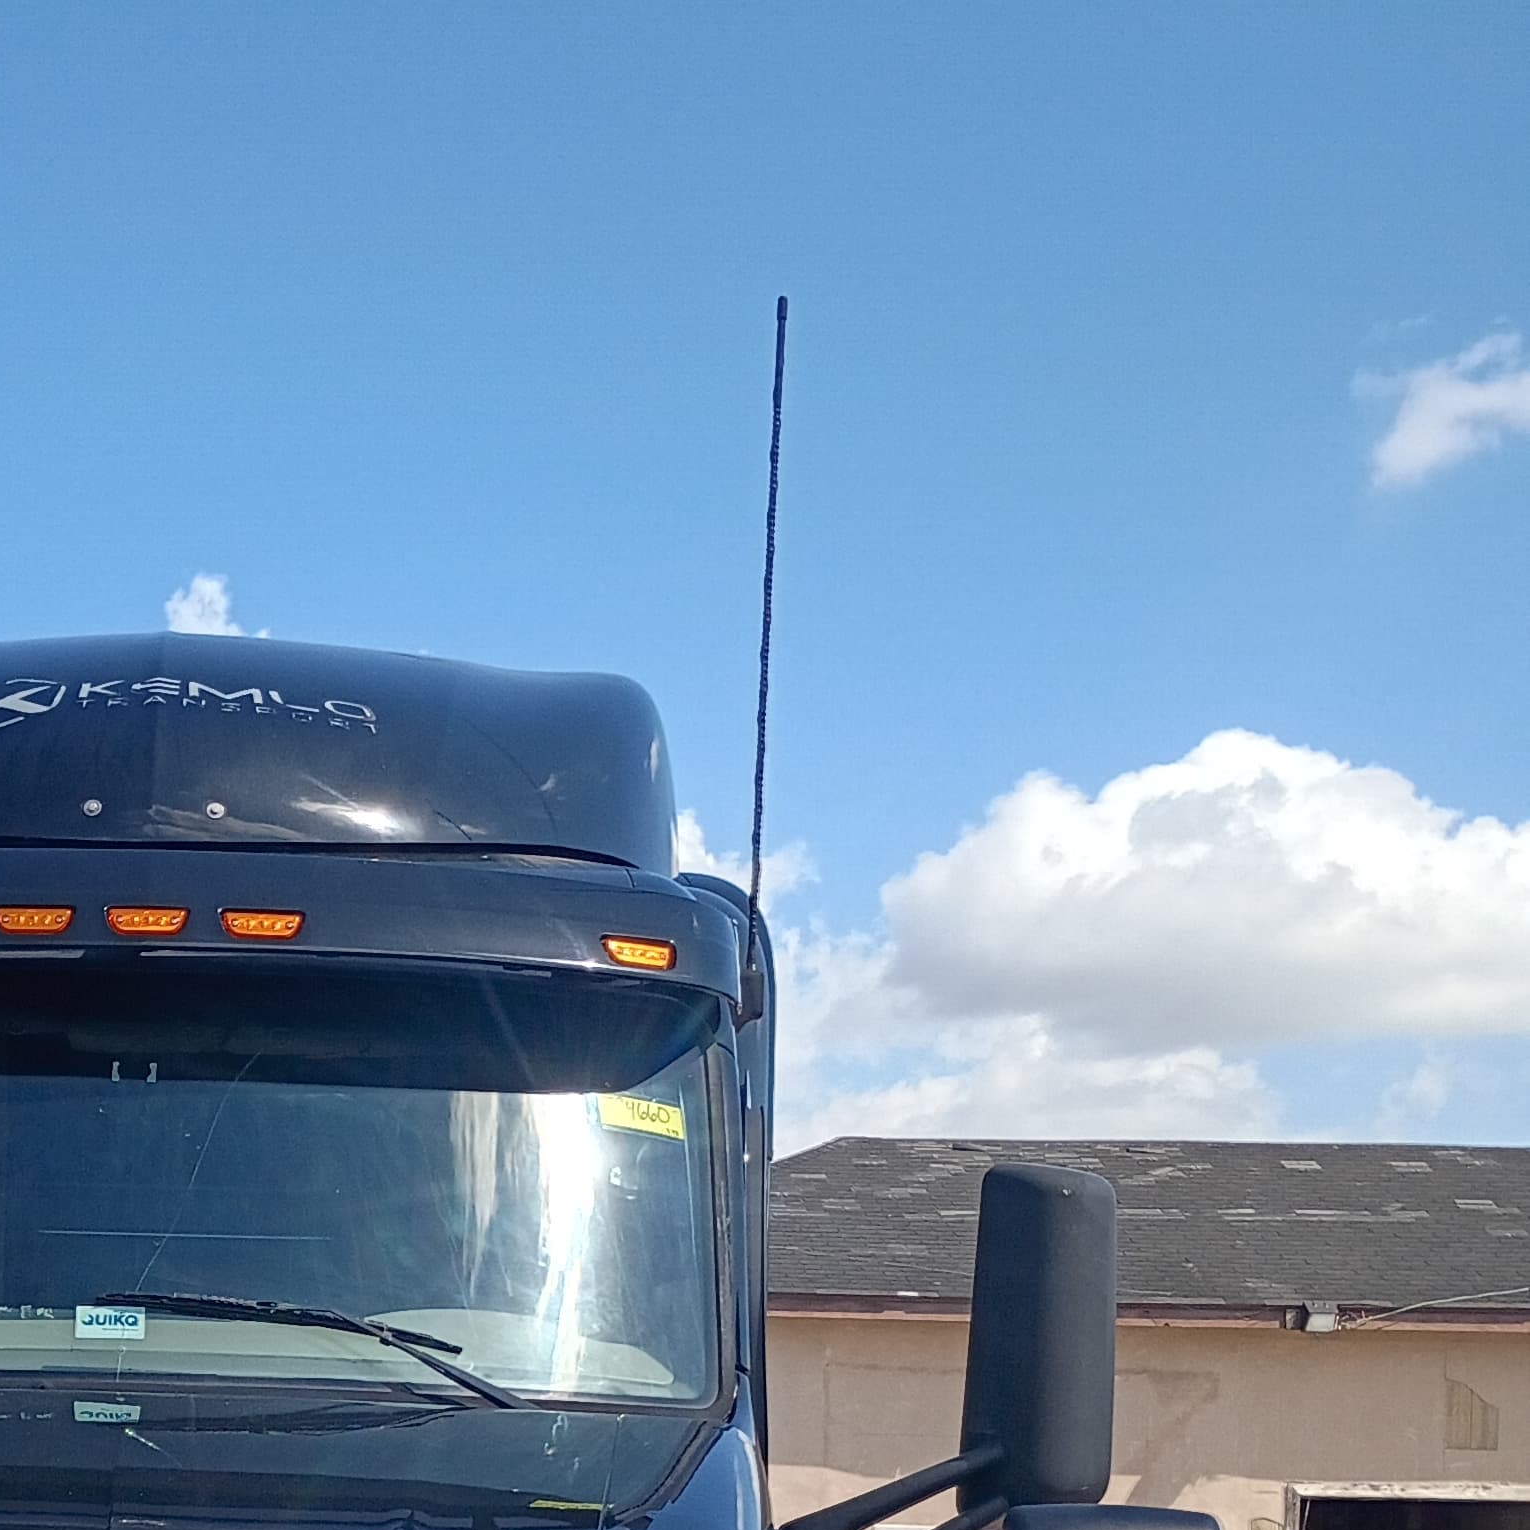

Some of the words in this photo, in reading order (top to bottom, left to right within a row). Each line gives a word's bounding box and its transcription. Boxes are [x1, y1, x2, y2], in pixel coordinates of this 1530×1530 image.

[77, 676, 377, 722] KEMLO
[625, 1100, 671, 1124] 4660
[80, 1313, 139, 1327] QUIKQ
